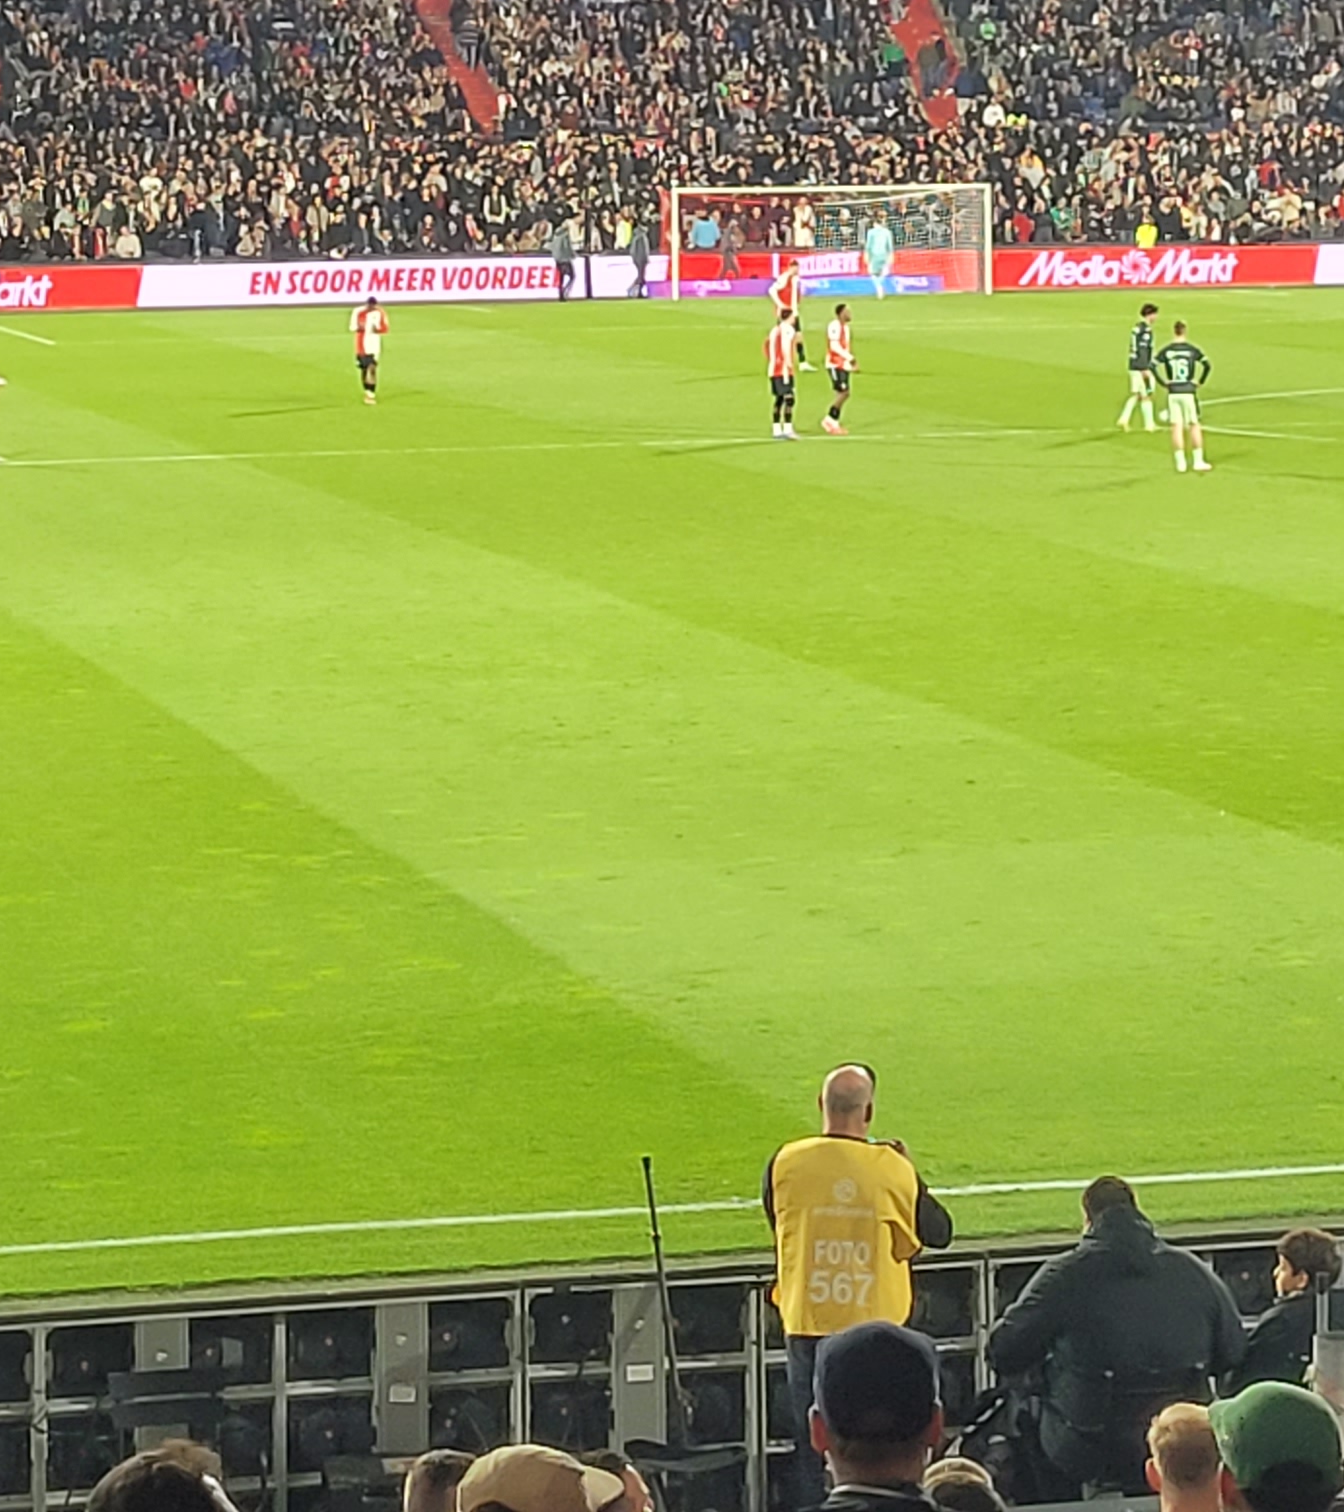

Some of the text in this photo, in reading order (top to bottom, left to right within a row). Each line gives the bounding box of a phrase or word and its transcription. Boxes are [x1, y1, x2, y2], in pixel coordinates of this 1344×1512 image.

[249, 272, 281, 295] EN
[285, 269, 363, 294] SCOOR
[367, 267, 437, 292] MEER
[1019, 249, 1238, 285] Media Markt
[1168, 359, 1190, 382] 16
[814, 1239, 870, 1265] FOTO
[809, 1270, 875, 1306] 567
